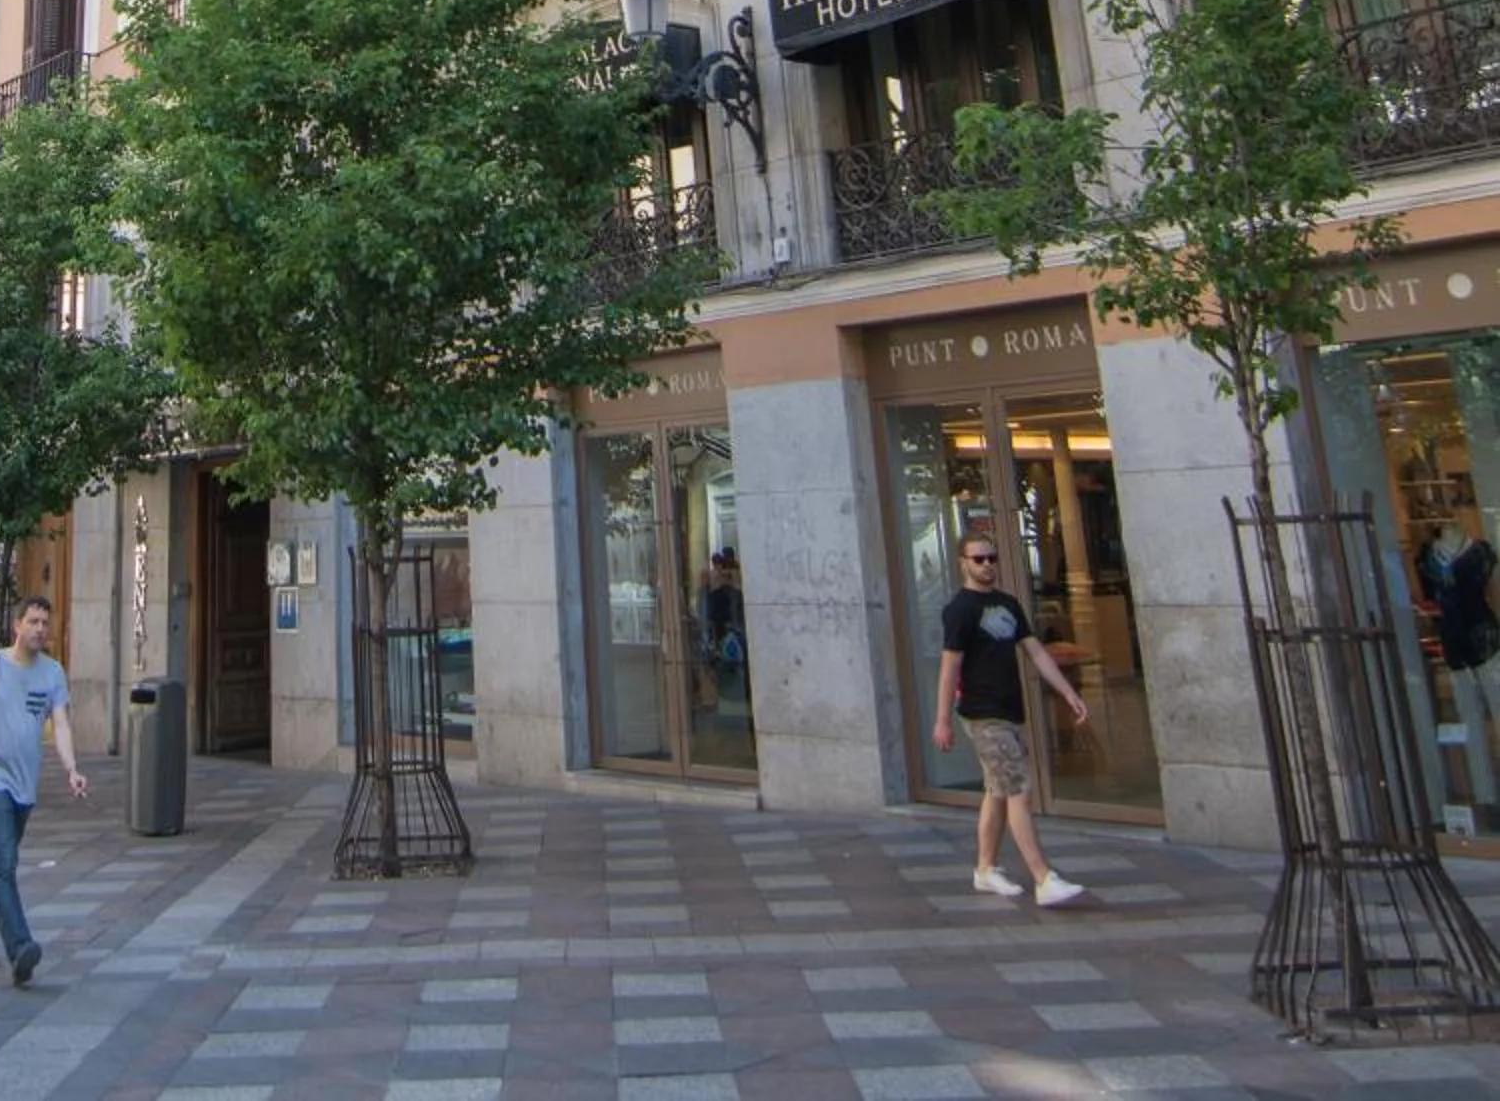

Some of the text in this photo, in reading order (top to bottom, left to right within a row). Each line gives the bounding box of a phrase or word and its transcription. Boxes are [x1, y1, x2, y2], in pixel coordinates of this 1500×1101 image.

[1333, 276, 1421, 313] UNT
[889, 322, 1087, 368] PUNT ROMA
